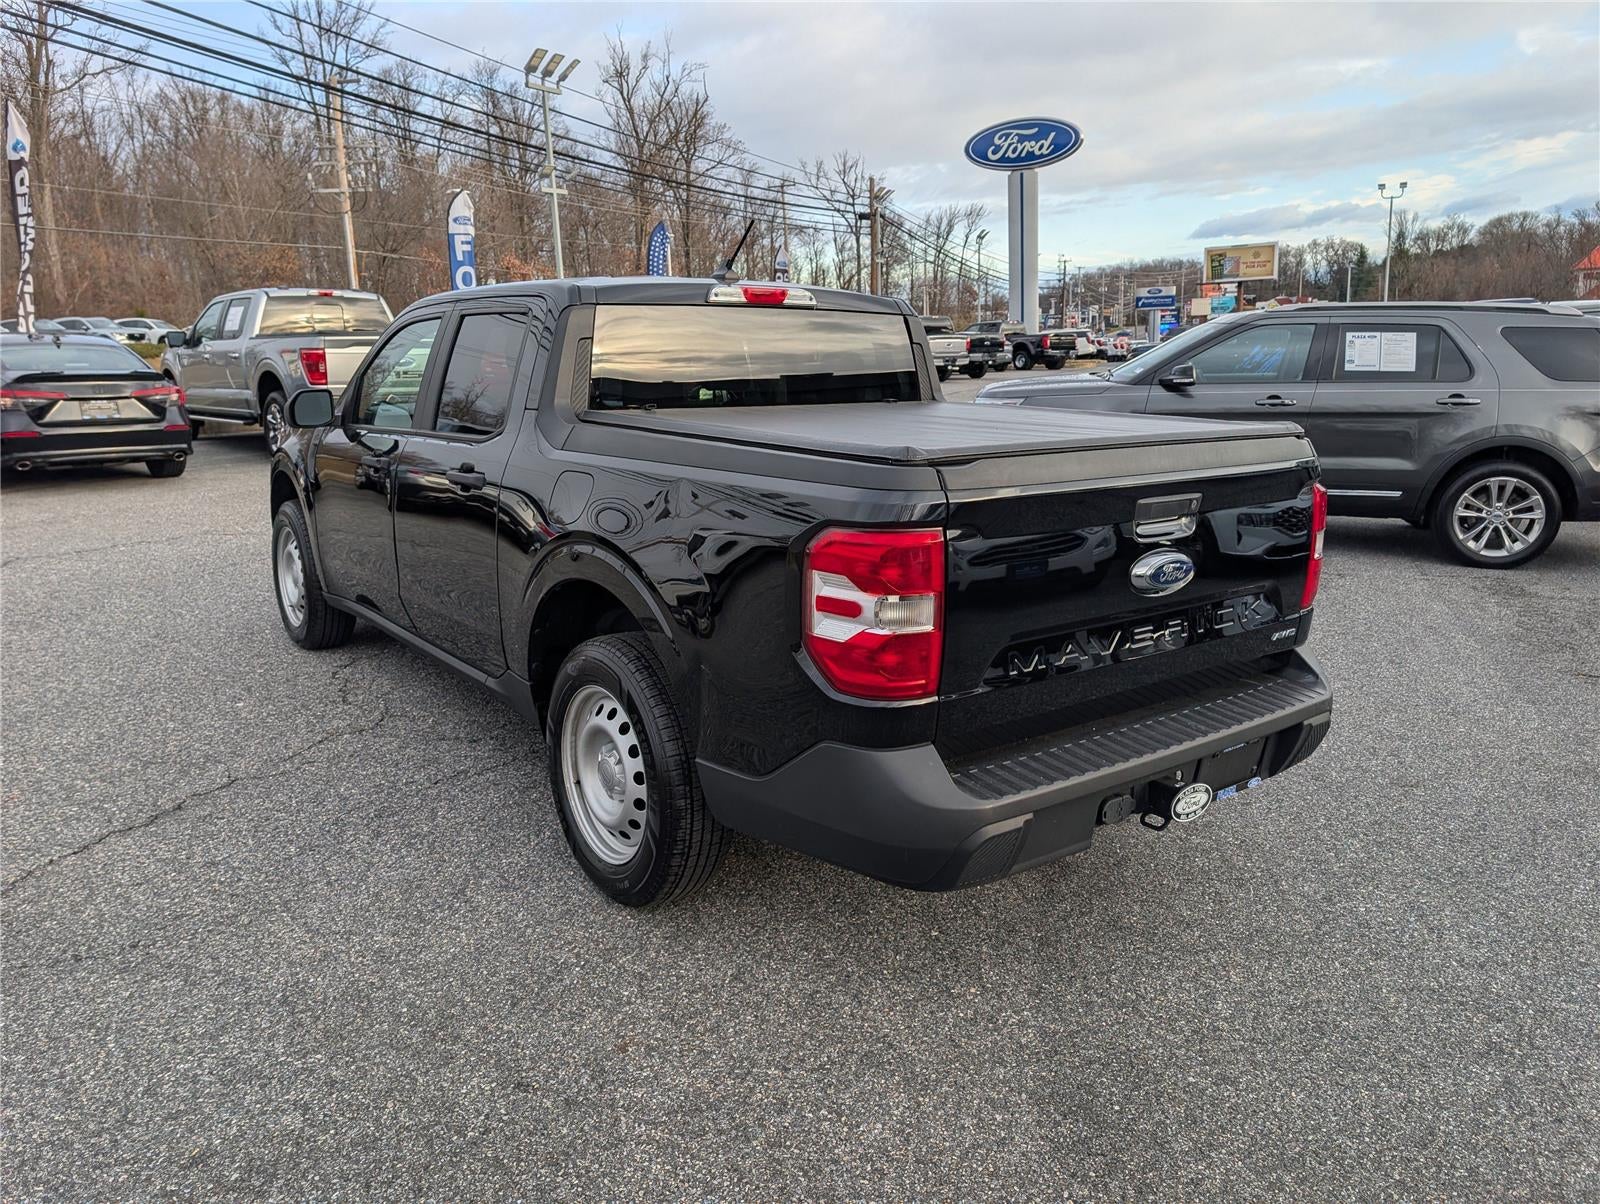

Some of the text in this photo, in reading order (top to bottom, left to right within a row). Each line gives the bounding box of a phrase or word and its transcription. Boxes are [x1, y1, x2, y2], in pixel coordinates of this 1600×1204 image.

[987, 127, 1056, 161] Ford
[1160, 563, 1187, 582] Ford
[1009, 598, 1262, 675] MAVERICK
